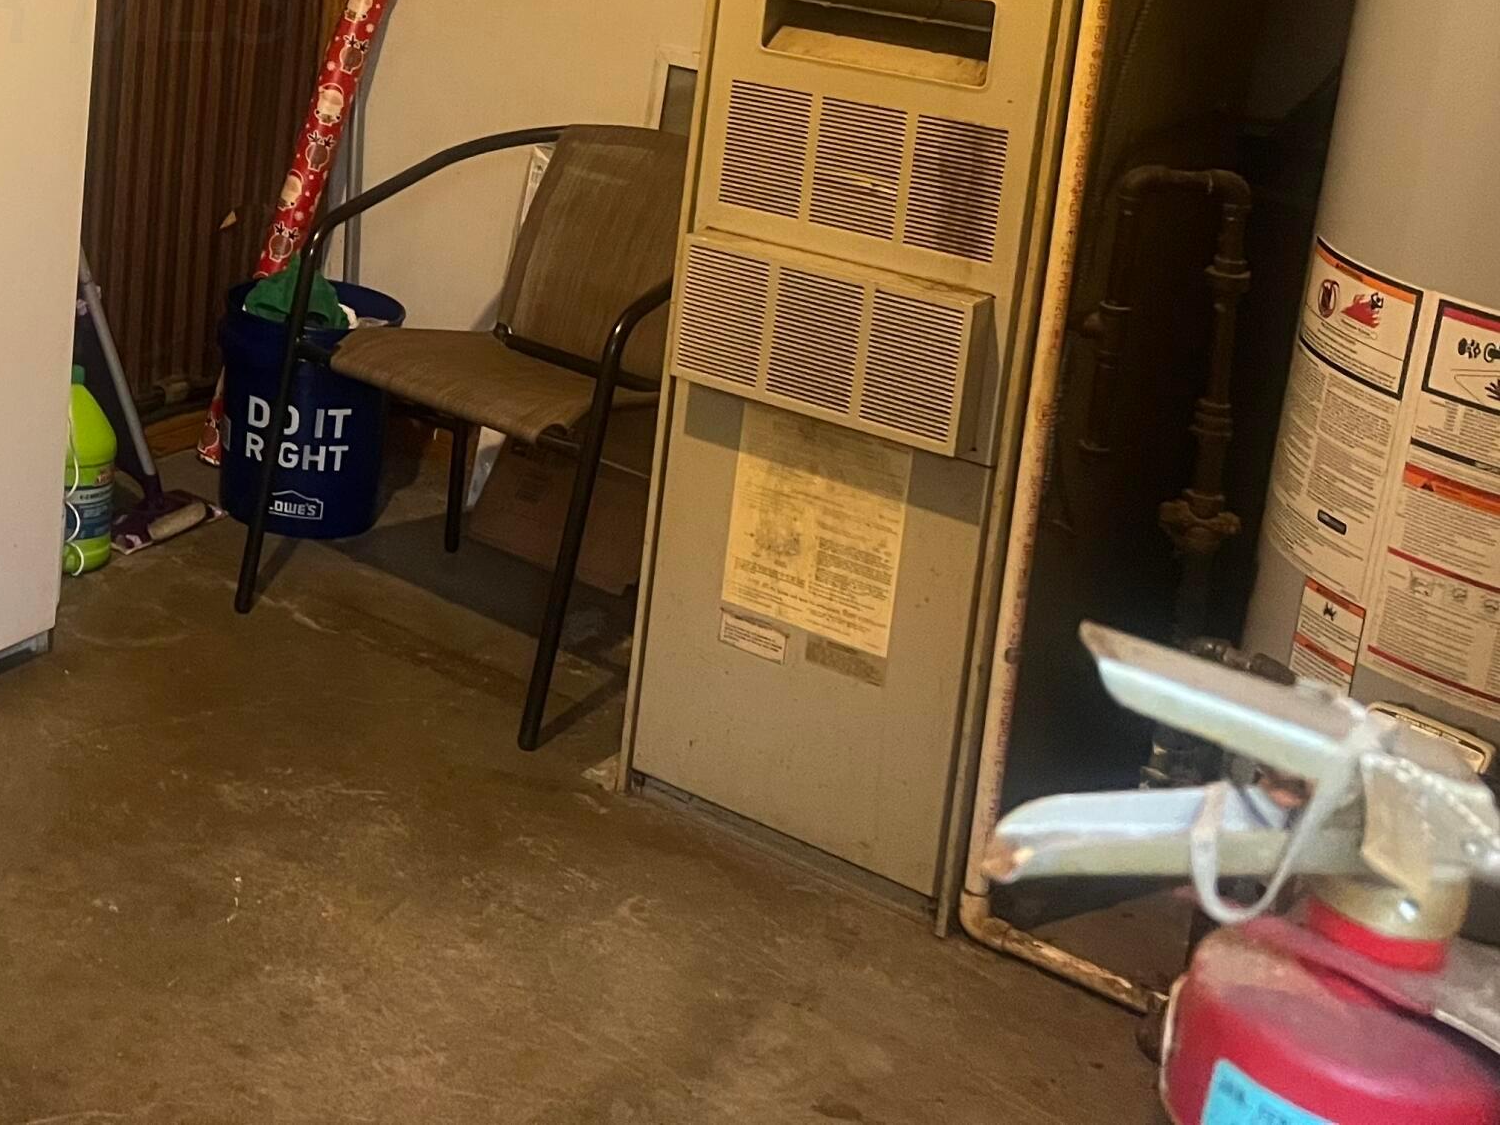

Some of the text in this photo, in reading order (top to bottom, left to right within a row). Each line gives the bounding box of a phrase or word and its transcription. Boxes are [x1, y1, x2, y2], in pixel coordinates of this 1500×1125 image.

[313, 408, 353, 440] IT
[244, 431, 349, 472] RGHT
[268, 499, 318, 517] OWE'S
